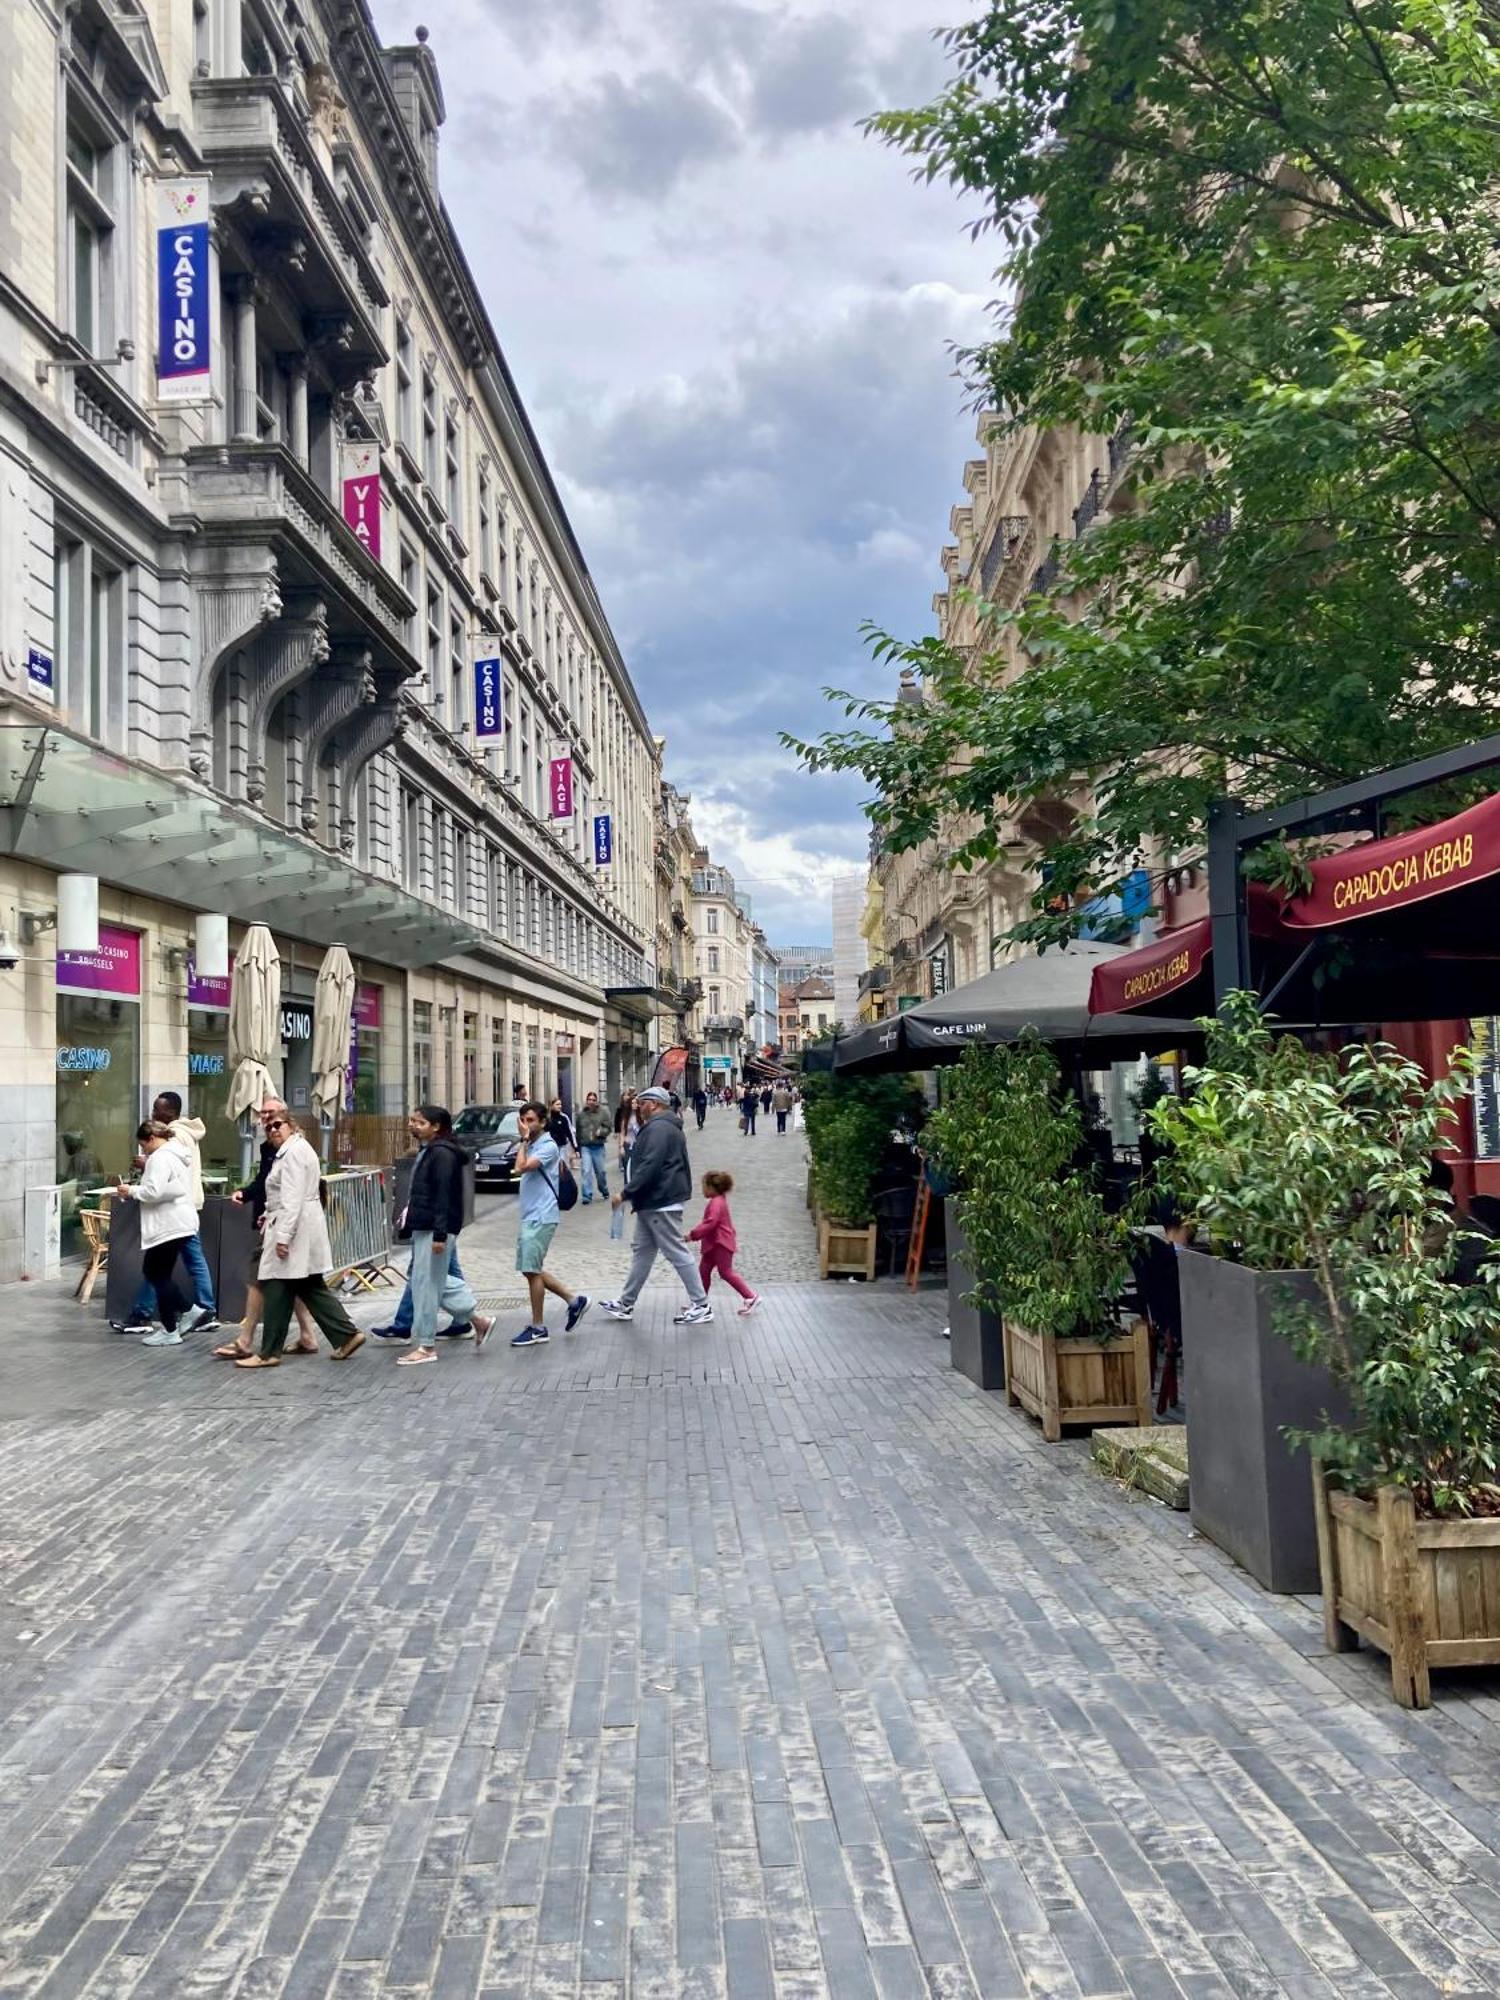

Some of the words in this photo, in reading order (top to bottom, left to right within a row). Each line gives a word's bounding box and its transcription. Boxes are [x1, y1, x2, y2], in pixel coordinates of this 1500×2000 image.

[174, 236, 196, 360] CASINO
[353, 486, 370, 545] VIA
[482, 665, 495, 727] CASINO
[556, 764, 567, 811] VIAGE
[598, 820, 607, 859] CASINO
[1334, 855, 1419, 909] CAPADOCIA
[1423, 834, 1473, 881] KEBAB
[104, 946, 129, 959] CASINO
[1124, 967, 1165, 999] CAPADOCIA
[1167, 950, 1189, 982] KEBAB
[280, 1011, 310, 1039] ASINO
[933, 1024, 963, 1036] CAFE
[57, 1047, 110, 1070] CASINO
[190, 1055, 224, 1074] VIAGE
